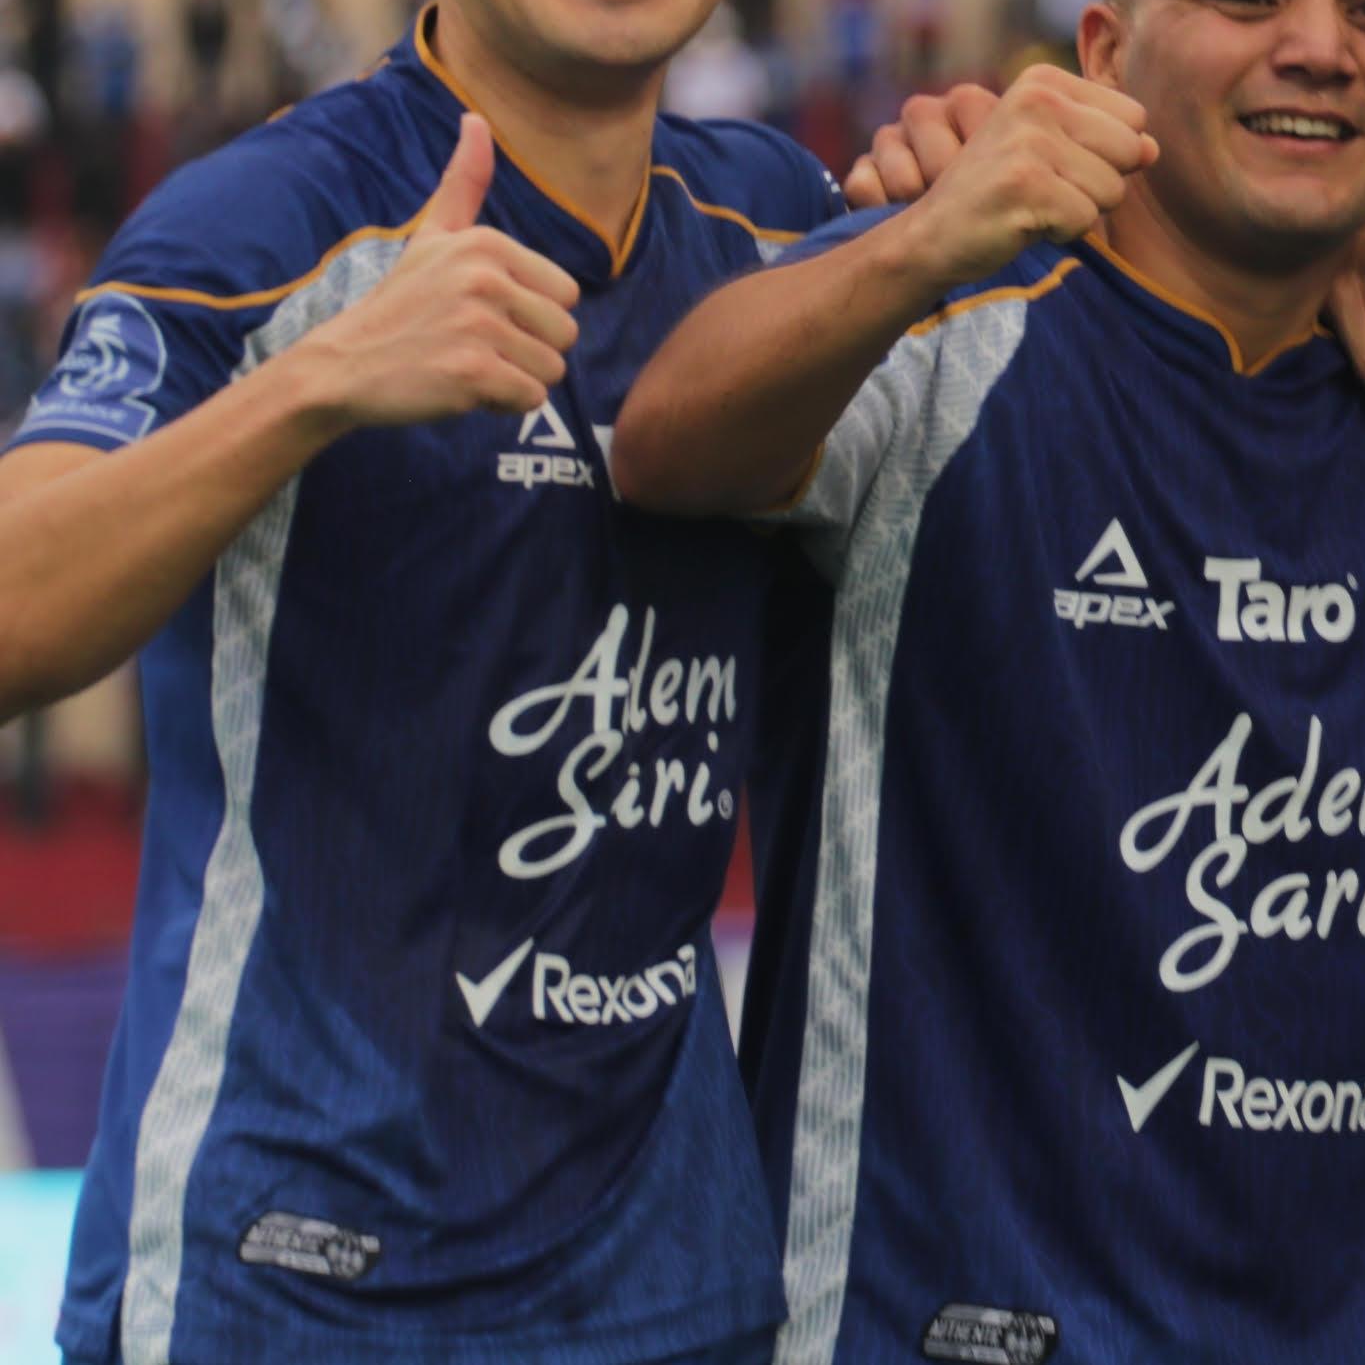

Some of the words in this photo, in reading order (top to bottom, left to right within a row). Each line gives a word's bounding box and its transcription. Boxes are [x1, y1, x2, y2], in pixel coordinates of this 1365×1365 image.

[497, 453, 594, 490] apex
[1054, 588, 1176, 630] apex
[1204, 557, 1356, 643] Taro
[533, 944, 696, 1025] Rexona
